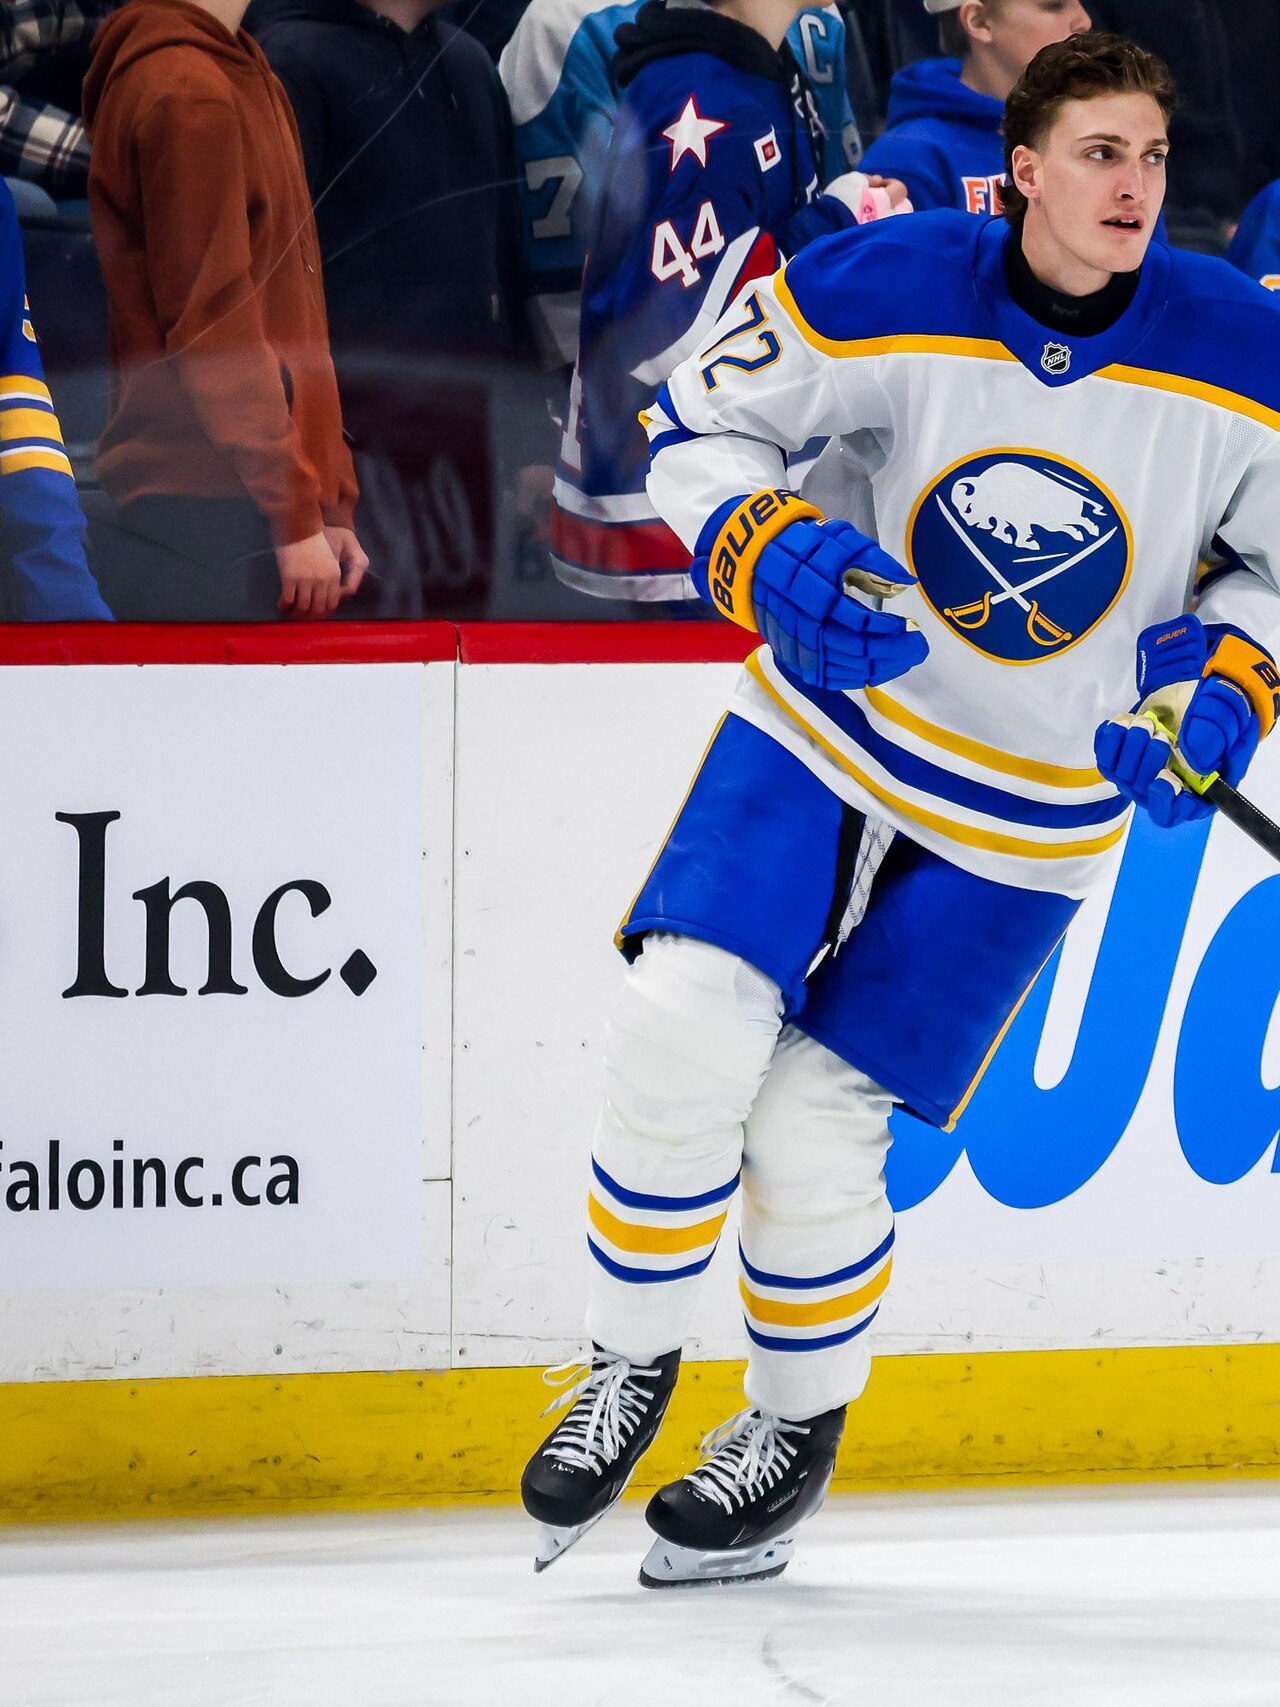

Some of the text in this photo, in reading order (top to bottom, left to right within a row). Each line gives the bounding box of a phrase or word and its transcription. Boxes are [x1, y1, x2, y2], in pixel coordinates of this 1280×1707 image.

[800, 14, 833, 84] C
[525, 155, 584, 240] 7
[651, 200, 726, 288] 44
[699, 290, 783, 394] 72
[1047, 352, 1066, 366] NHL
[55, 810, 378, 998] Inc.
[0, 1140, 300, 1212] aloinc.ca
